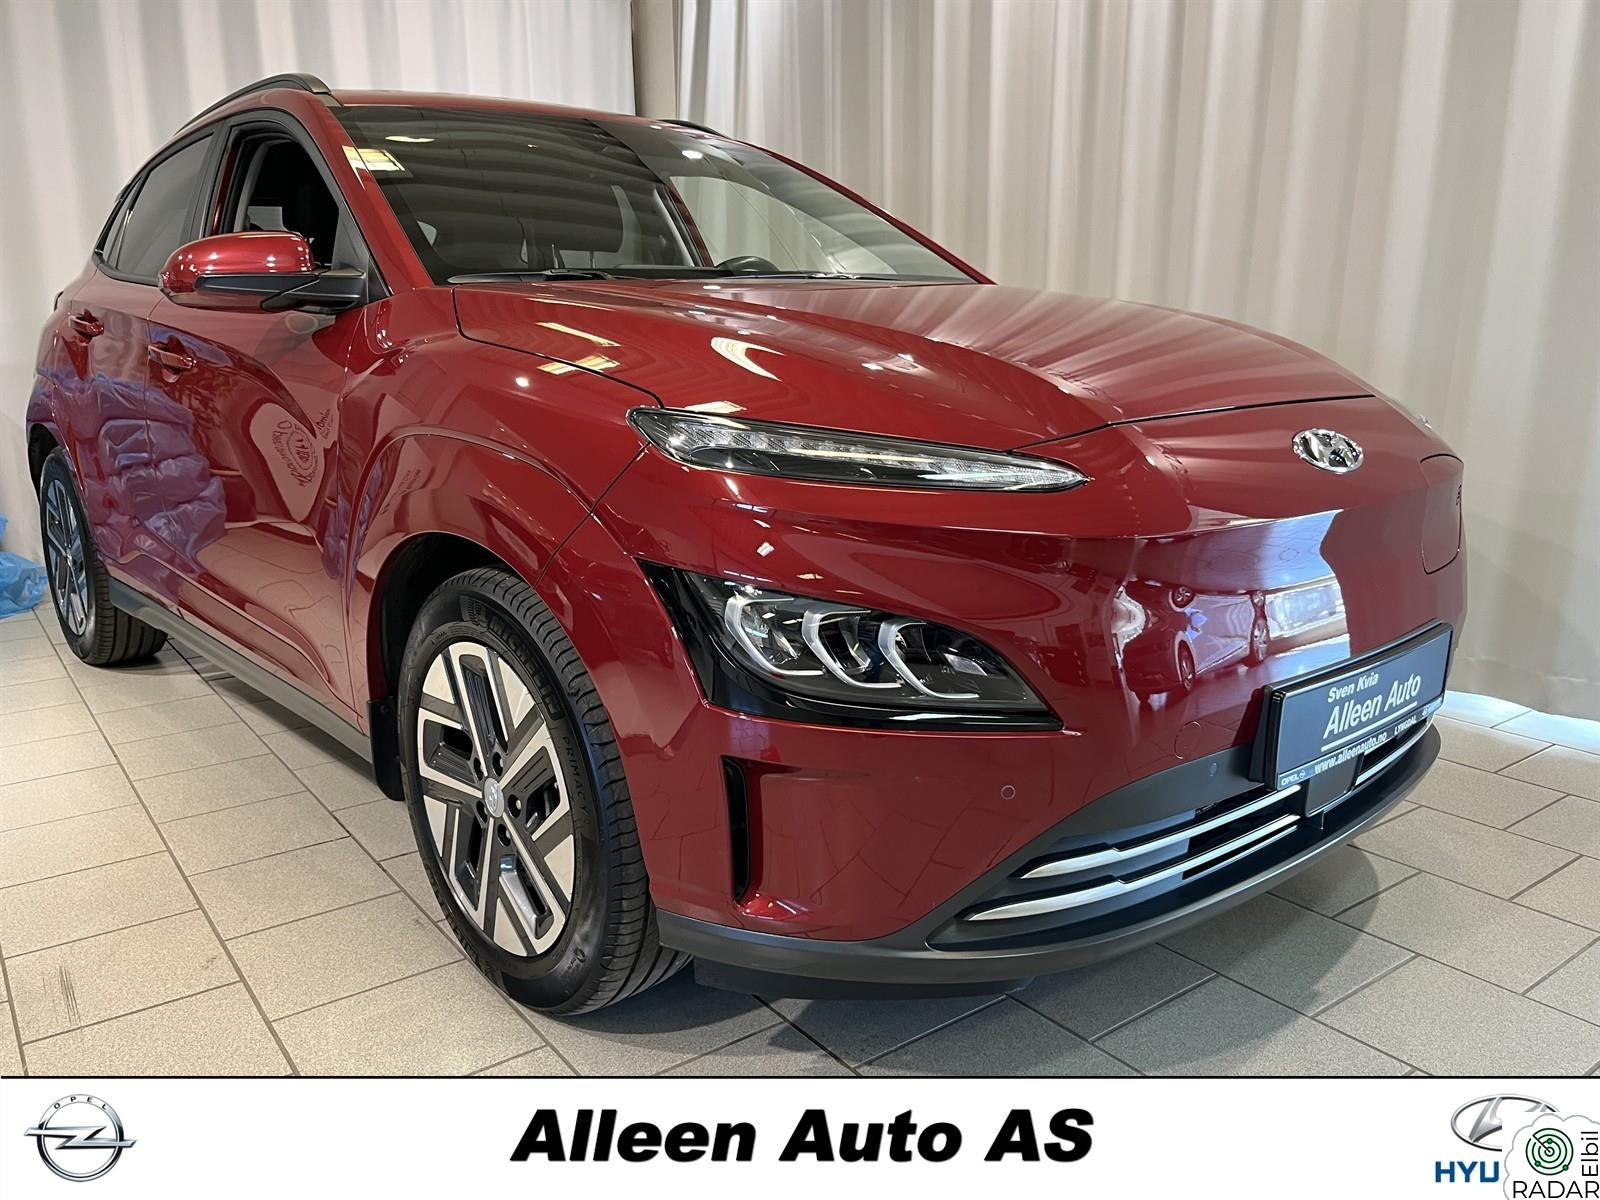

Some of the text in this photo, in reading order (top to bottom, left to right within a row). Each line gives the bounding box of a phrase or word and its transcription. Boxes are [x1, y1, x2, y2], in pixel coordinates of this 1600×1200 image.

[1322, 694, 1383, 740] Alleen
[1383, 673, 1421, 712] Auto
[1327, 672, 1379, 703] Sven Kvia
[562, 736, 592, 816] PRIMACY
[1314, 731, 1387, 774] www.alleenauto.no
